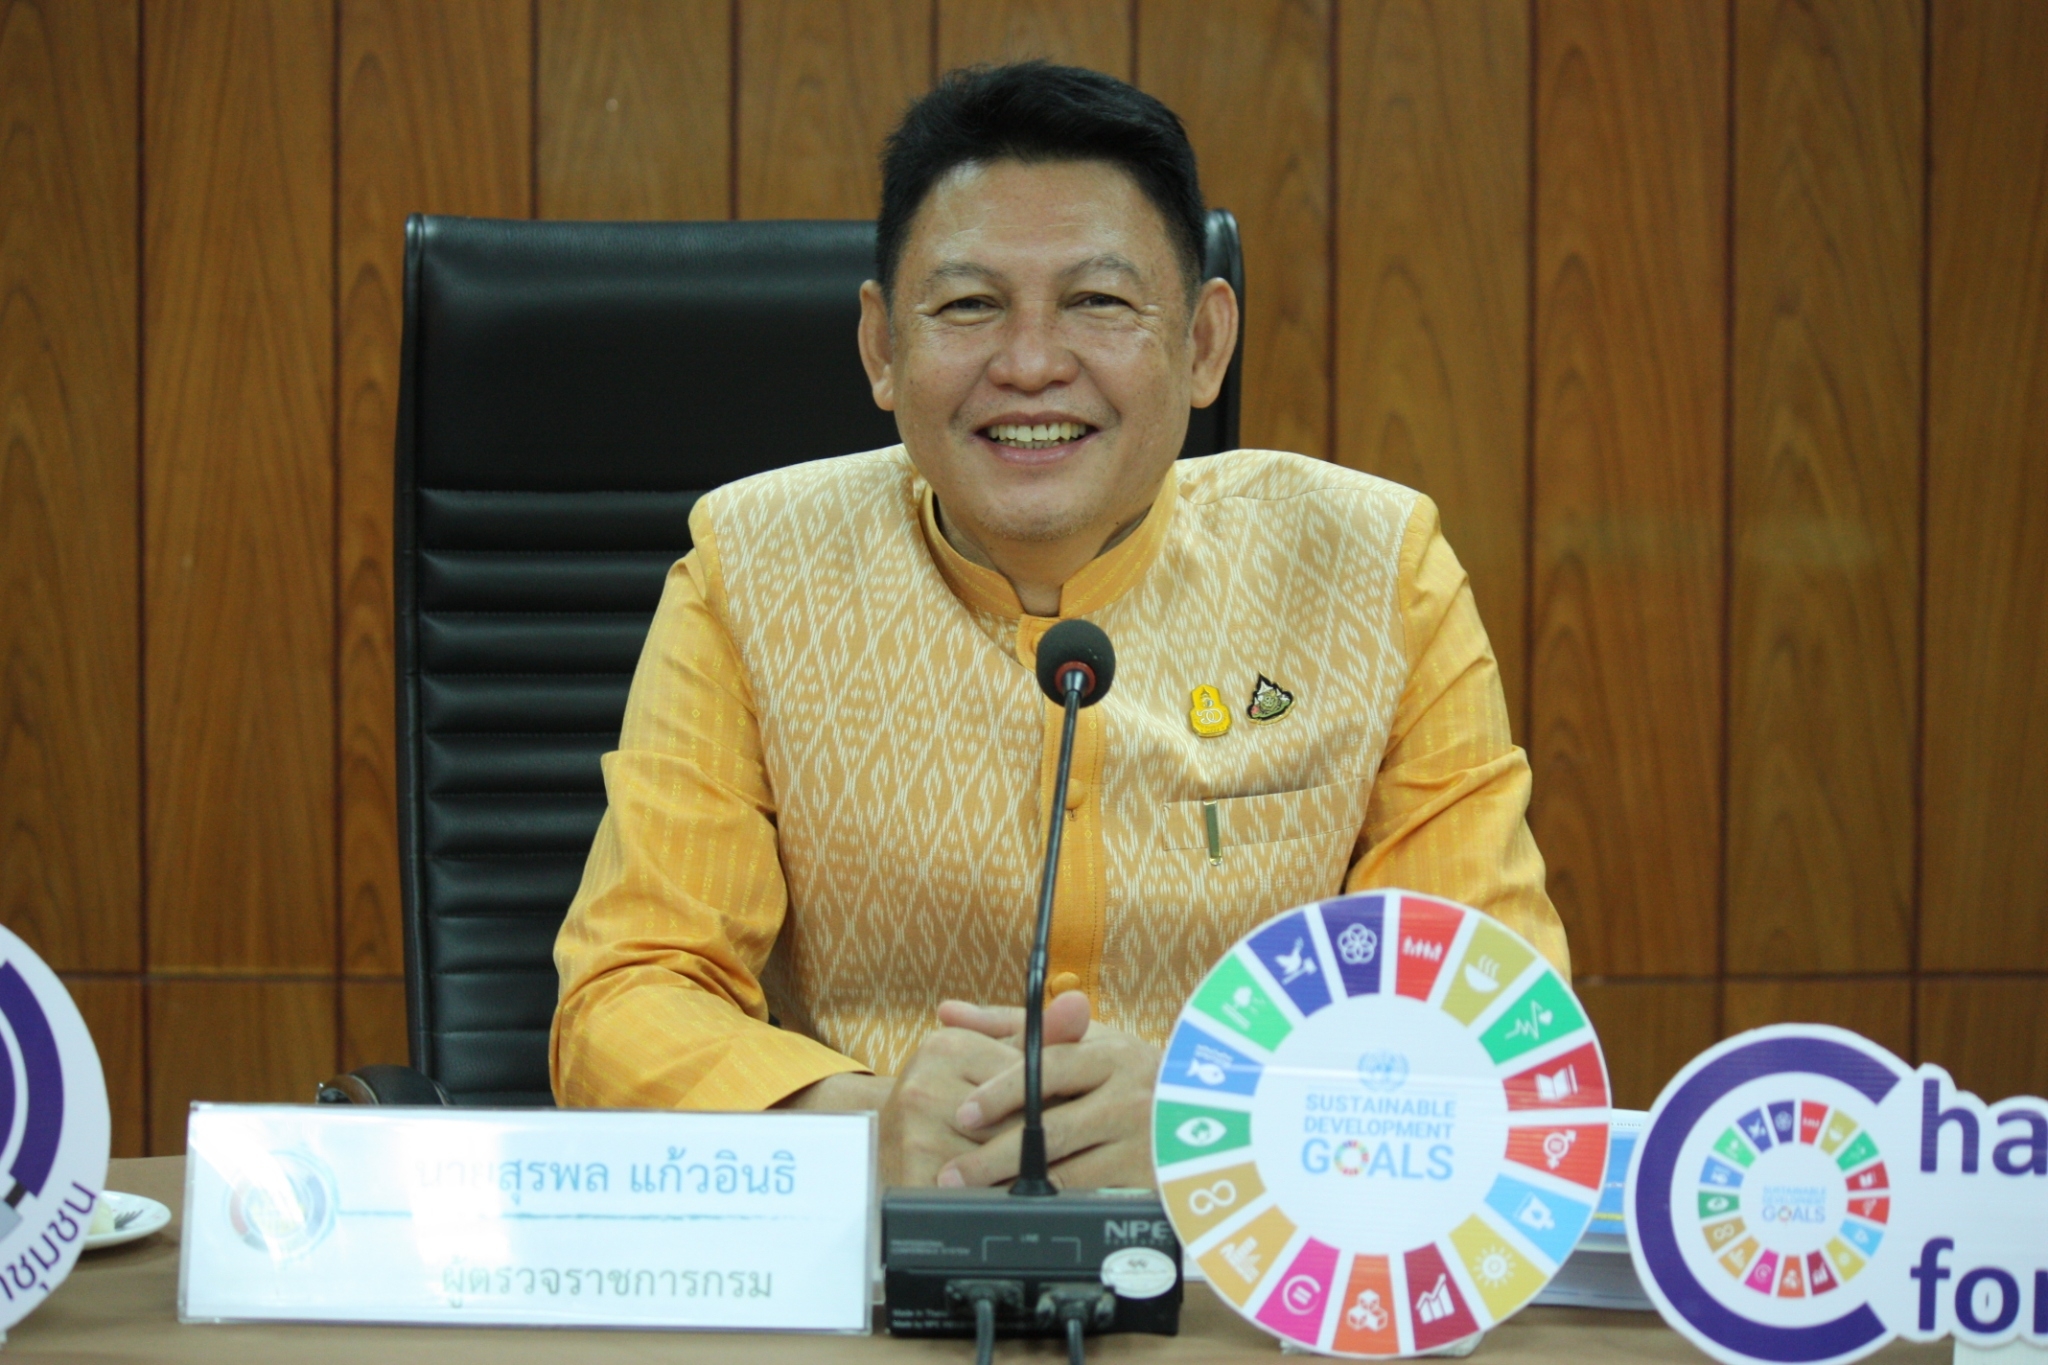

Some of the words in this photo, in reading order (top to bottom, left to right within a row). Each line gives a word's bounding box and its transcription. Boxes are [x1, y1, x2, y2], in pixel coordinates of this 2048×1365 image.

[1306, 1094, 1456, 1119] SUSTAINABLE
[1303, 1117, 1455, 1140] DEVELOPMENT
[630, 1145, 797, 1195] แก้วอินธิ
[1301, 1139, 1454, 1181] GOALS
[1762, 1204, 1826, 1223] GOALS
[1104, 1219, 1171, 1239] NPE
[442, 1254, 775, 1309] ผู้ตรวจราชการกรม
